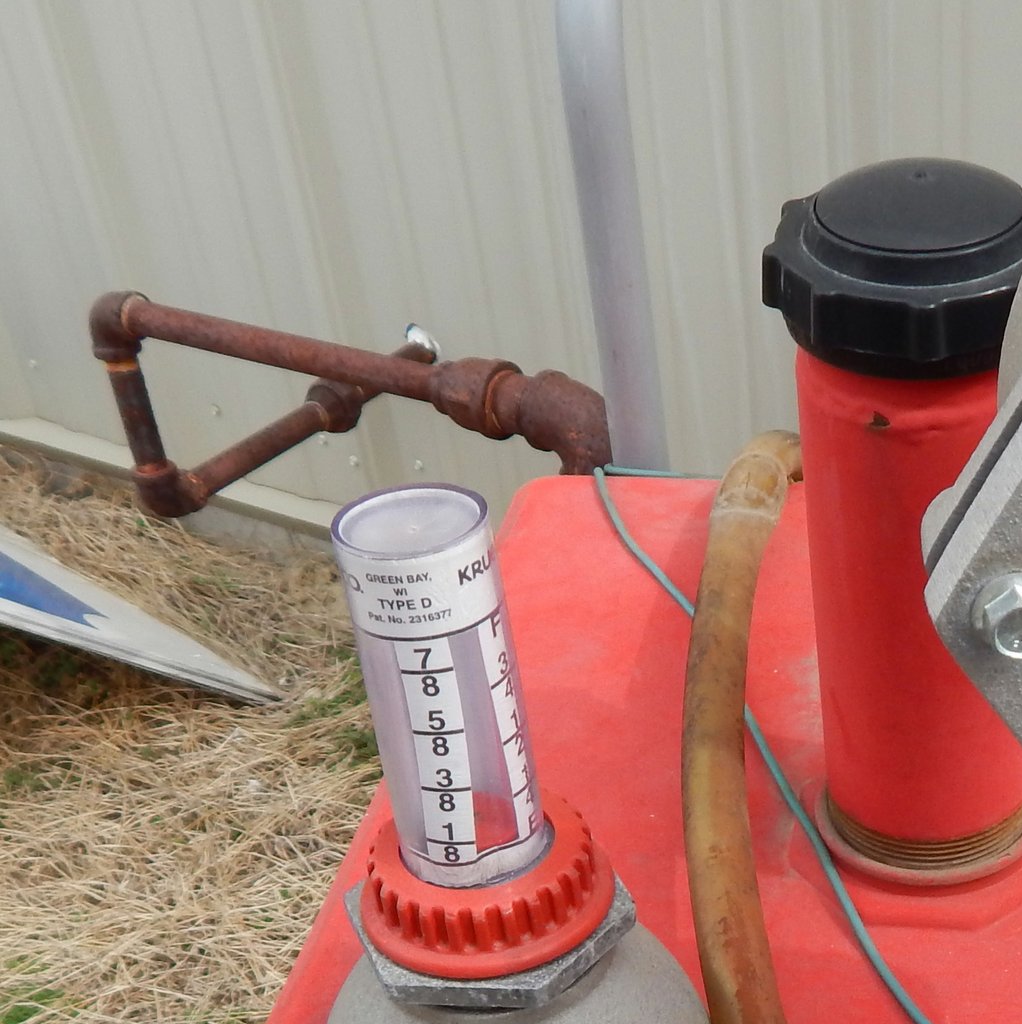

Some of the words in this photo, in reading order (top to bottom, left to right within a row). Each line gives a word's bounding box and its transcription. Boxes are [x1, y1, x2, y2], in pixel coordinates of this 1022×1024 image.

[365, 573, 404, 584] GREEN
[393, 588, 408, 596] WI
[377, 598, 416, 611] TYPE
[421, 597, 432, 610] D
[388, 615, 406, 625] No.
[408, 608, 451, 624] 2316377
[413, 648, 432, 669] 7
[497, 651, 509, 674] 3
[421, 675, 440, 697] 8
[504, 676, 514, 698] 4
[428, 710, 446, 731] 5
[432, 736, 450, 757] 8
[436, 768, 453, 788] 3
[439, 793, 456, 812] 8
[442, 822, 454, 841] 1
[444, 845, 460, 863] 8
